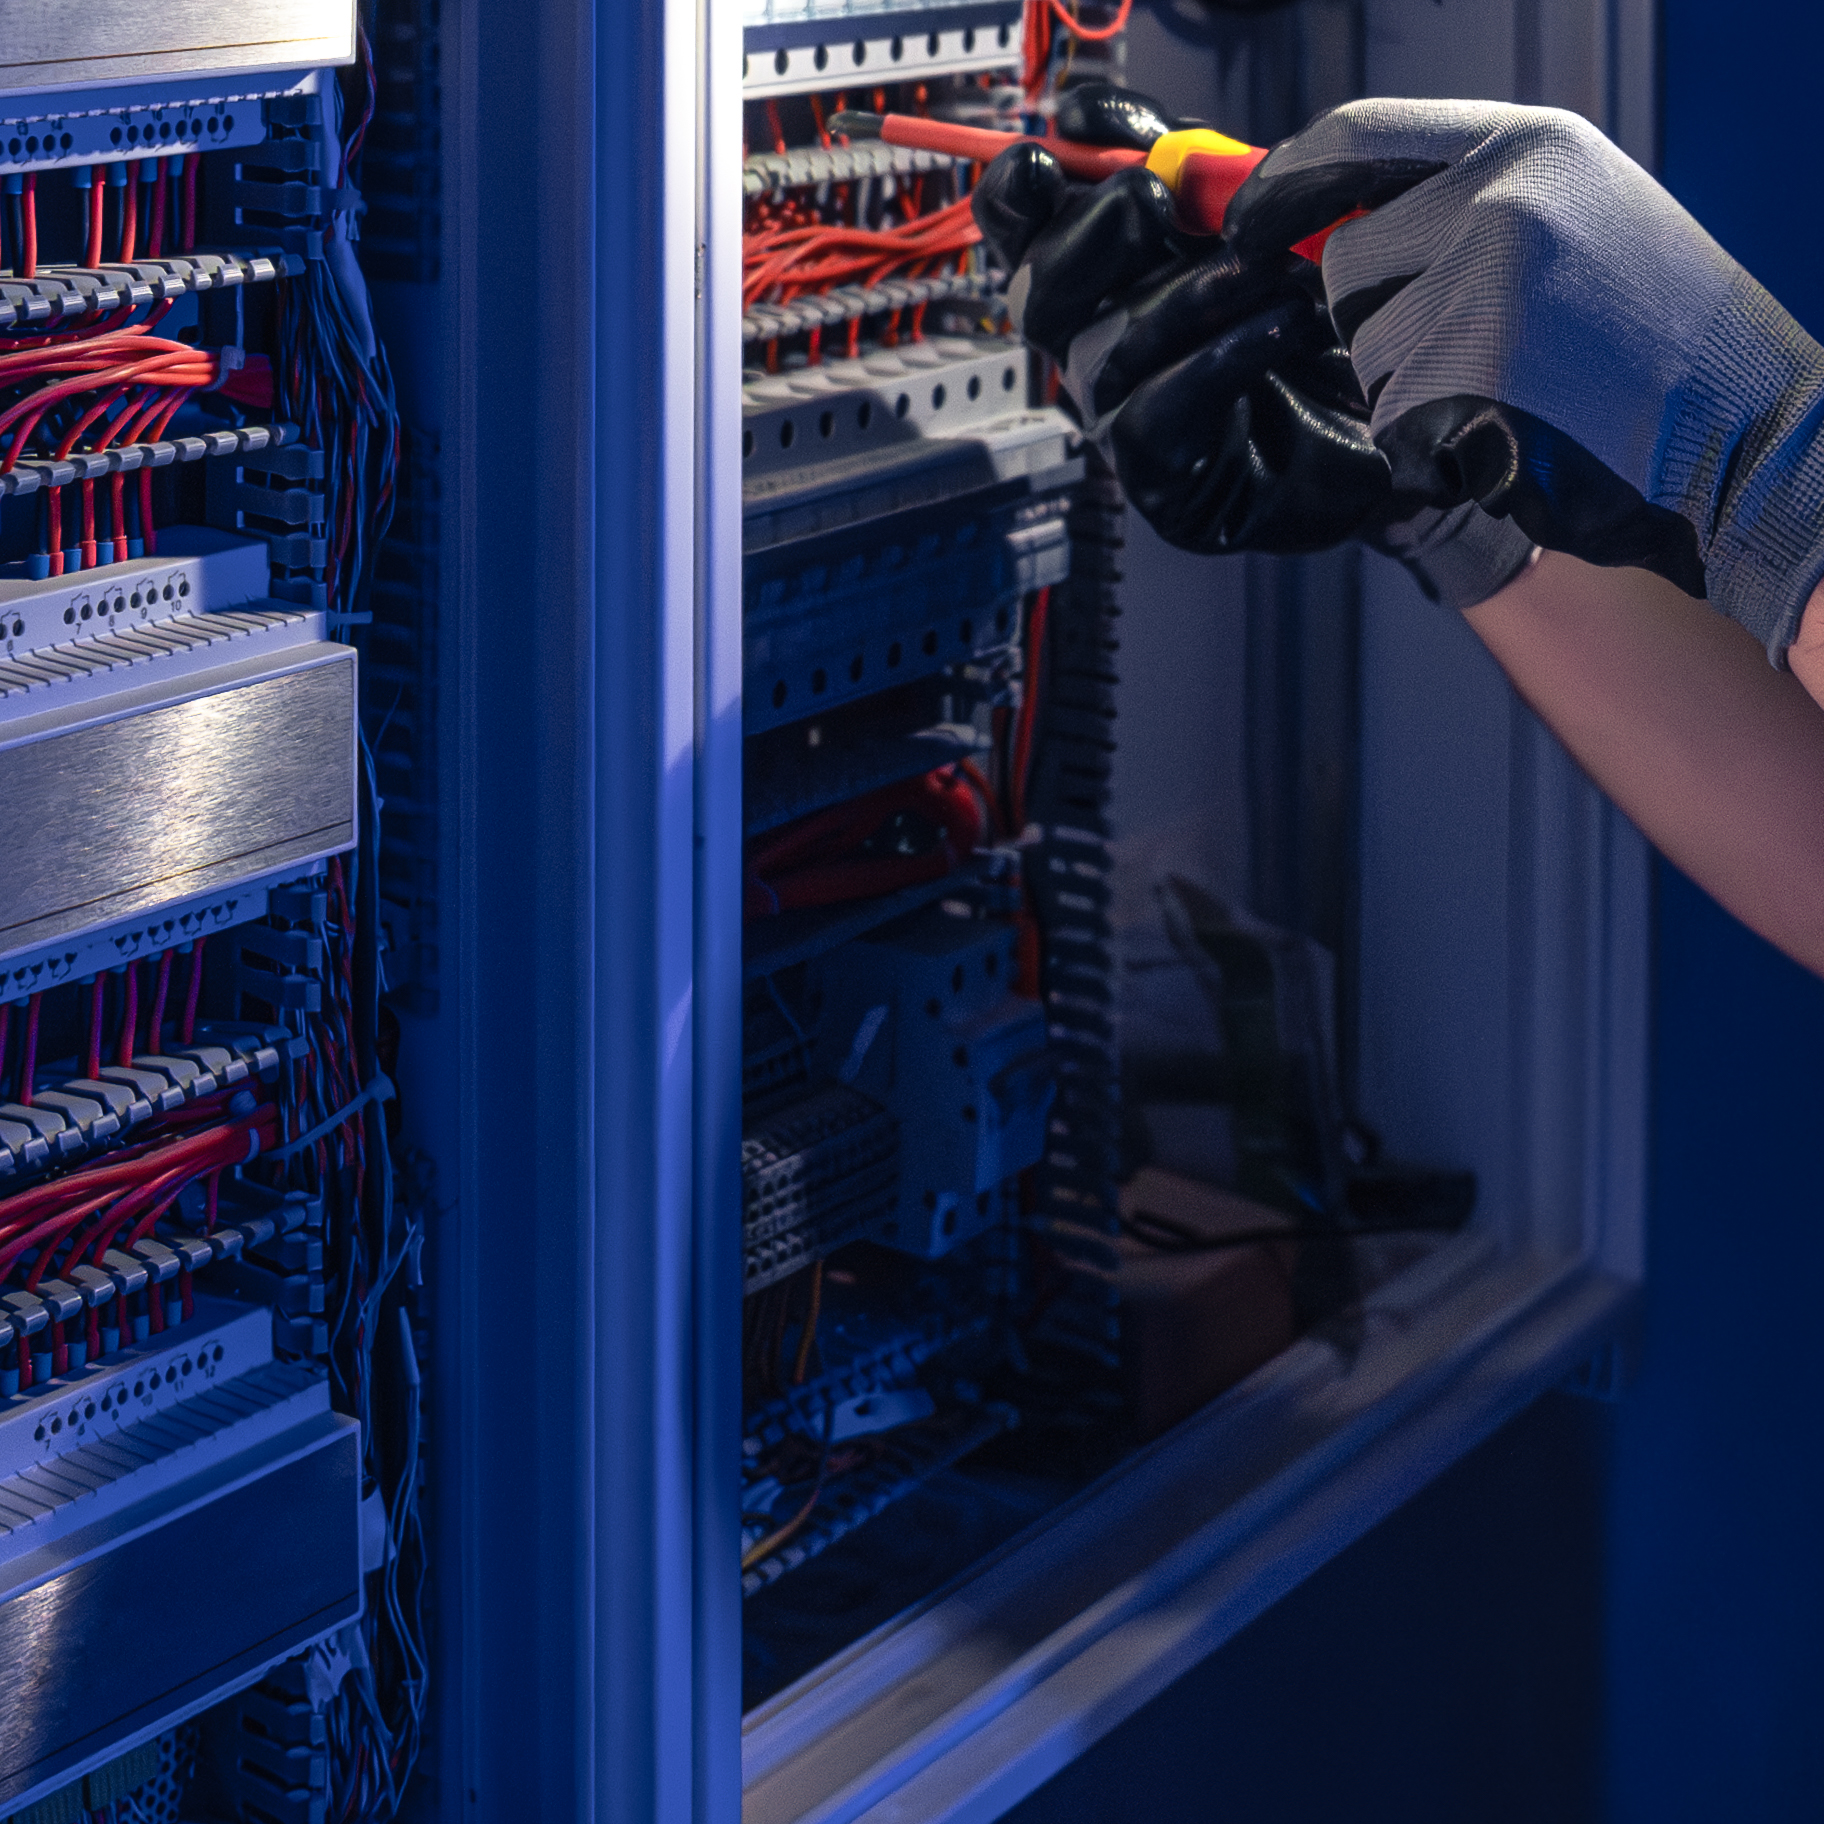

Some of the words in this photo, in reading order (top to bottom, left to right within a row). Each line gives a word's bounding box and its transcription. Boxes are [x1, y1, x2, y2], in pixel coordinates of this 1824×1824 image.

[75, 622, 82, 635] 7
[140, 607, 148, 620] 9
[170, 599, 182, 612] 10
